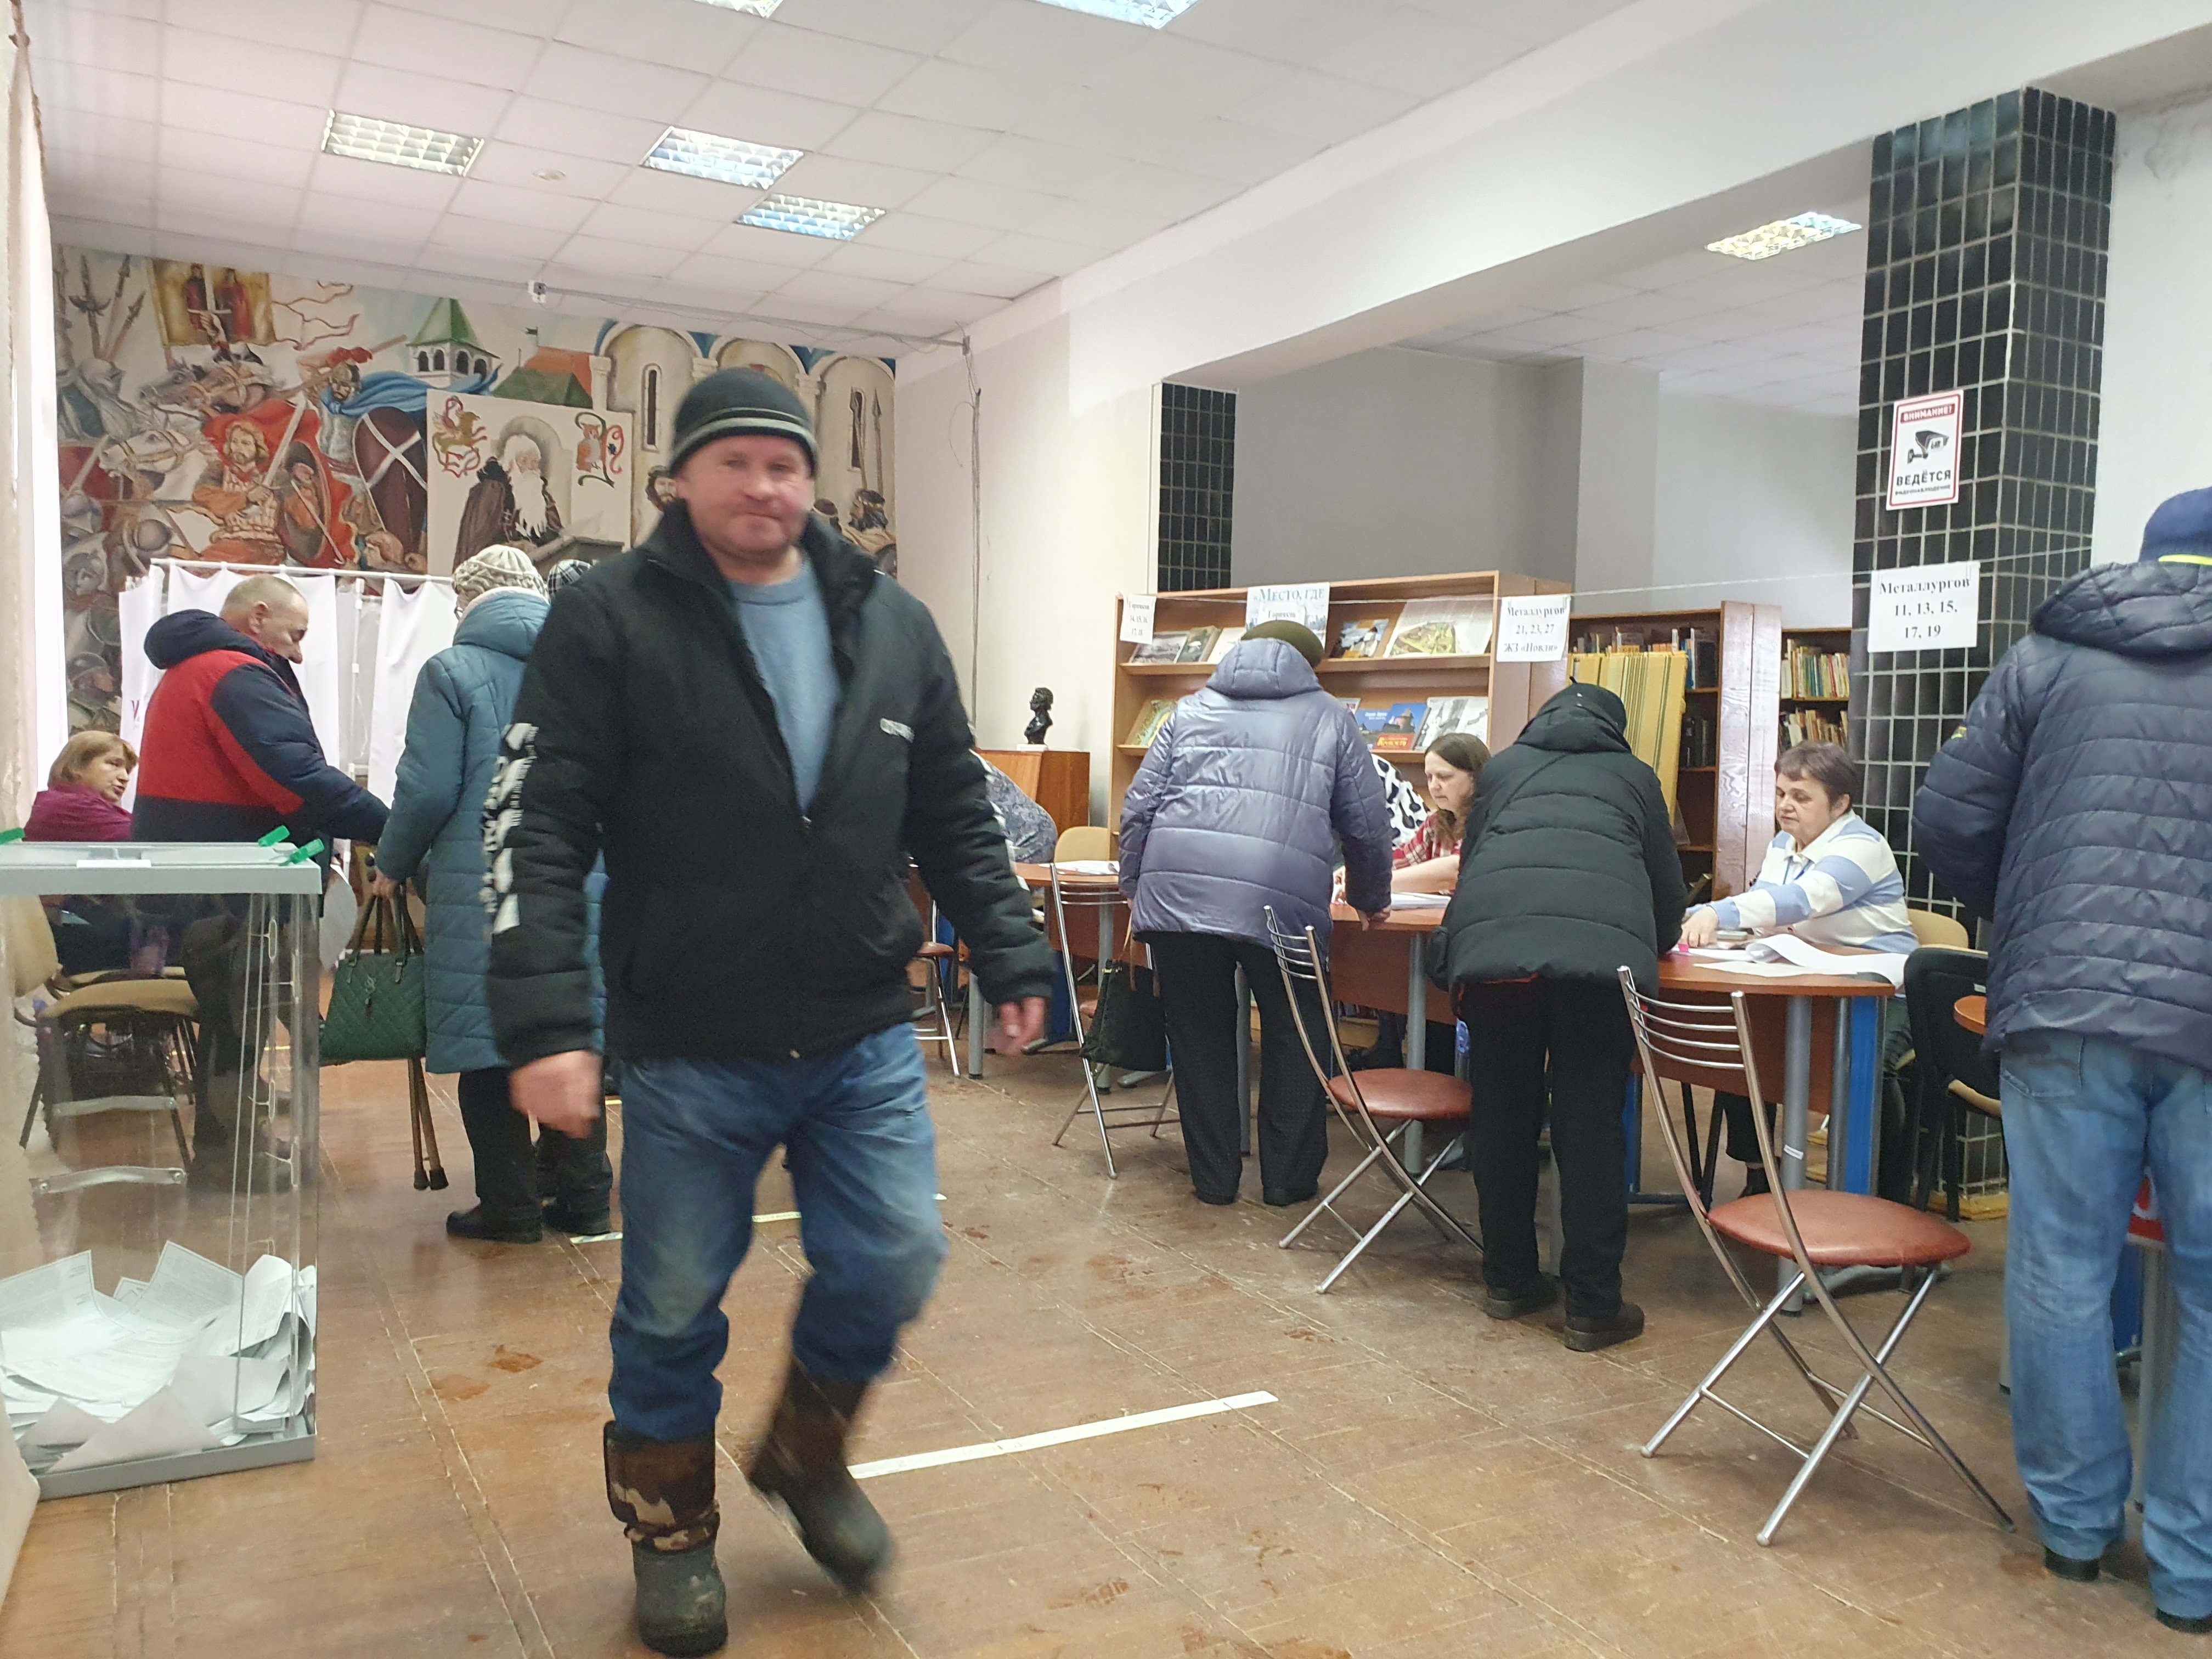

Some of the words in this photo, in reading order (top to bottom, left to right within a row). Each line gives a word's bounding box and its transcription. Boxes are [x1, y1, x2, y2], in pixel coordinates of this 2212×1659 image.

[1903, 405, 1952, 421] ВНИМАНИЕ!
[1897, 469, 1951, 486] ВЕДЁТСЯ
[1880, 578, 1970, 595] Металлургов
[1507, 607, 1565, 618] Металлургов
[1895, 605, 1911, 616] 11,
[1917, 602, 1934, 614] 13,
[1940, 600, 1957, 613] 15,
[1516, 625, 1527, 635] 21,
[1545, 624, 1554, 634] 27
[1905, 627, 1922, 639] 17,
[1928, 625, 1941, 637] 19
